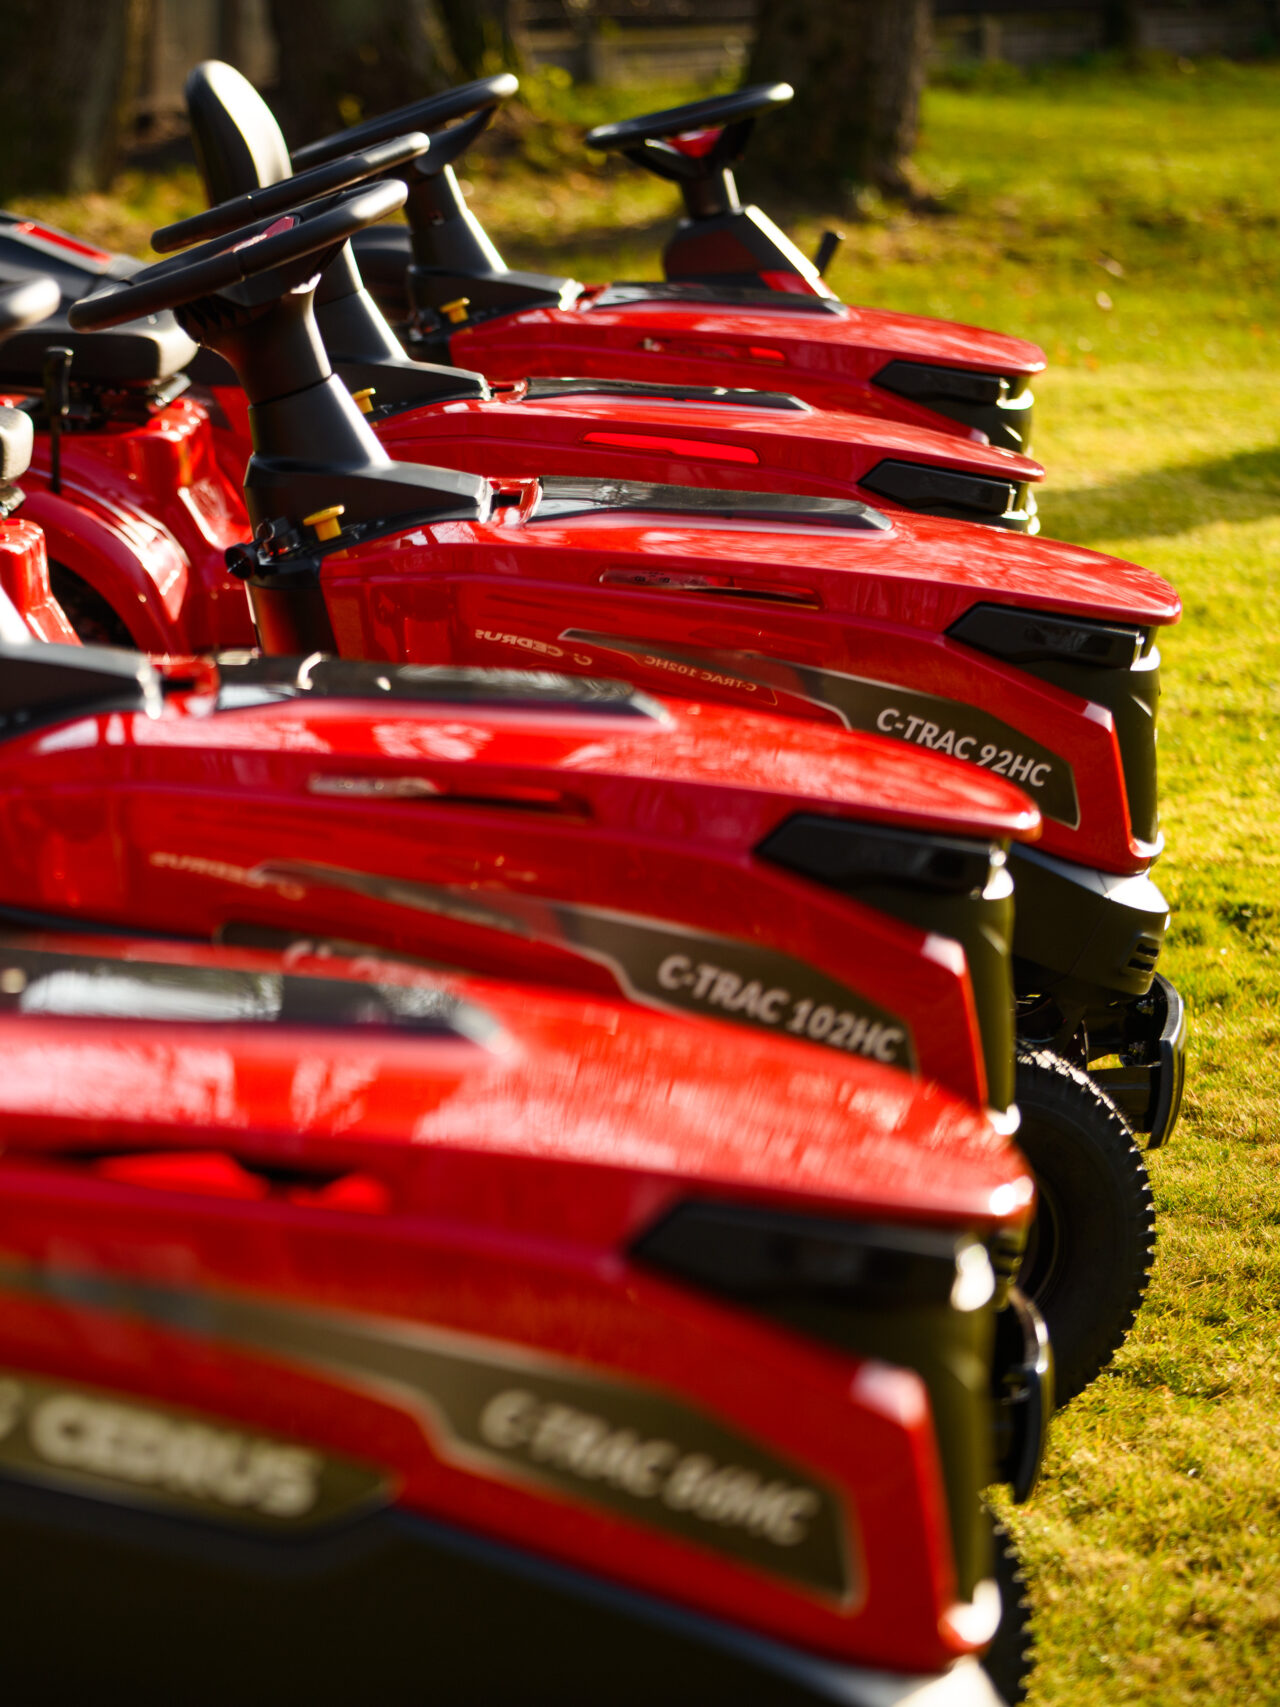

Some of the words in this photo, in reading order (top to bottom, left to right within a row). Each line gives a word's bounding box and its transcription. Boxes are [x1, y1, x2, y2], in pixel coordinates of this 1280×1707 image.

[876, 708, 977, 760] C-TRAC
[976, 744, 1052, 787] 92HC
[657, 955, 789, 1024] C-TRAC
[786, 998, 904, 1062] 102HC
